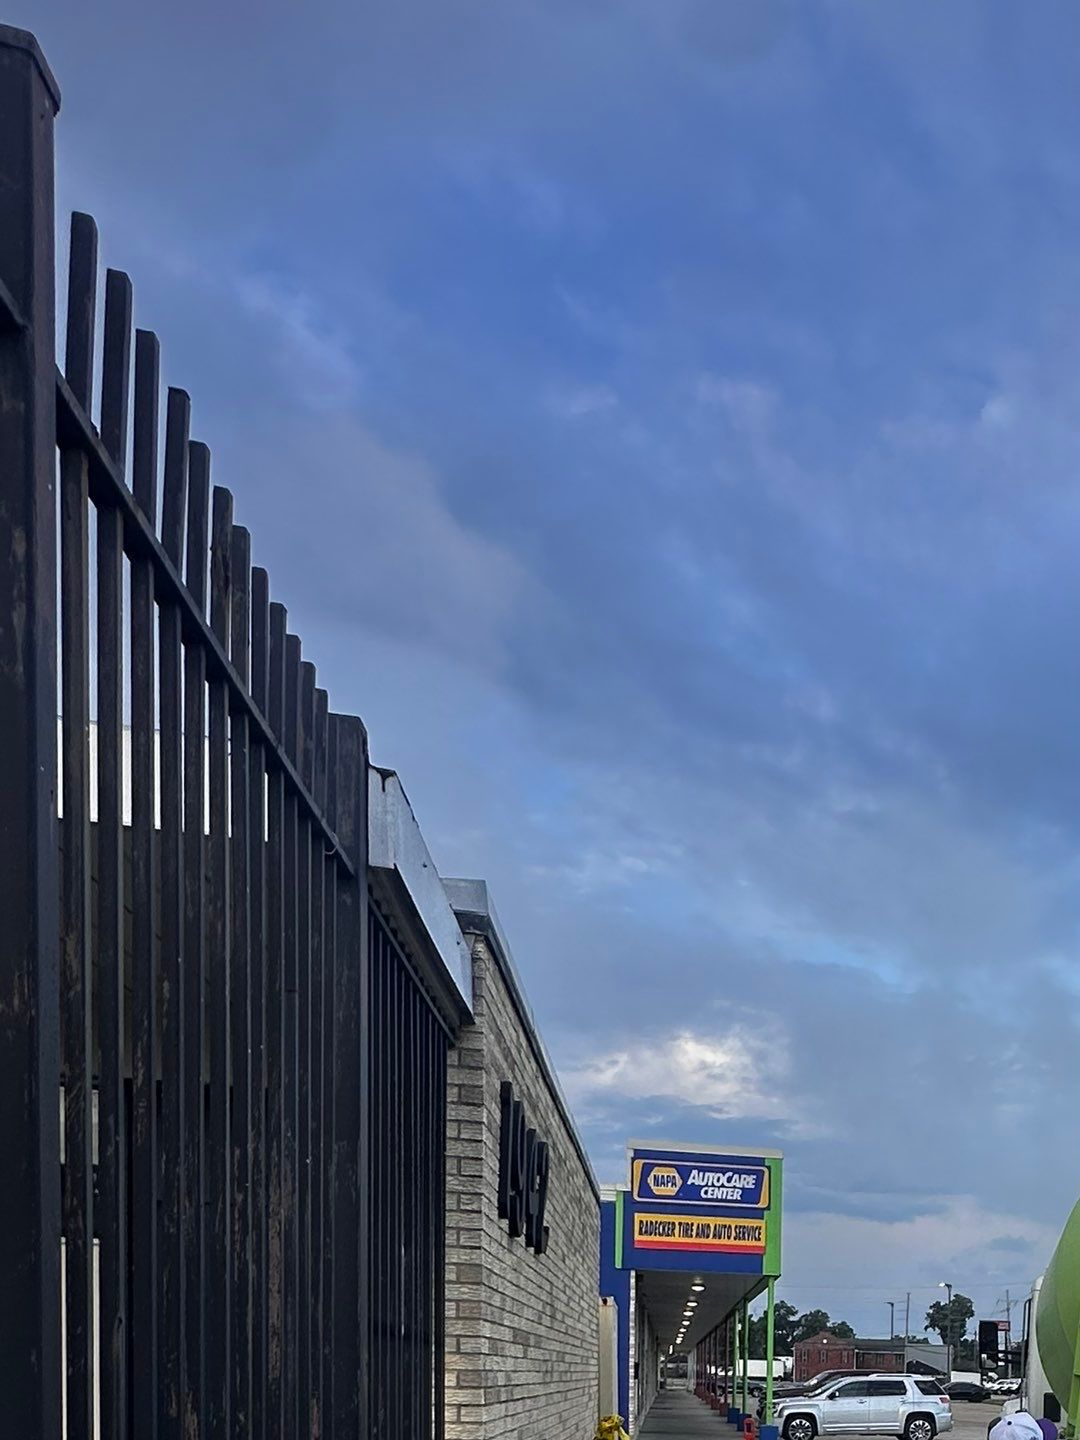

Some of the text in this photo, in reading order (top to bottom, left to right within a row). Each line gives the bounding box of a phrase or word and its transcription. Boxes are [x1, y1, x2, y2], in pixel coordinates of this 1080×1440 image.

[653, 1173, 677, 1188] NAPA
[687, 1169, 757, 1188] AUTOCARE
[700, 1186, 743, 1200] CENTER
[638, 1219, 762, 1242] RADECKER TIRE AND AUTO SERVICE
